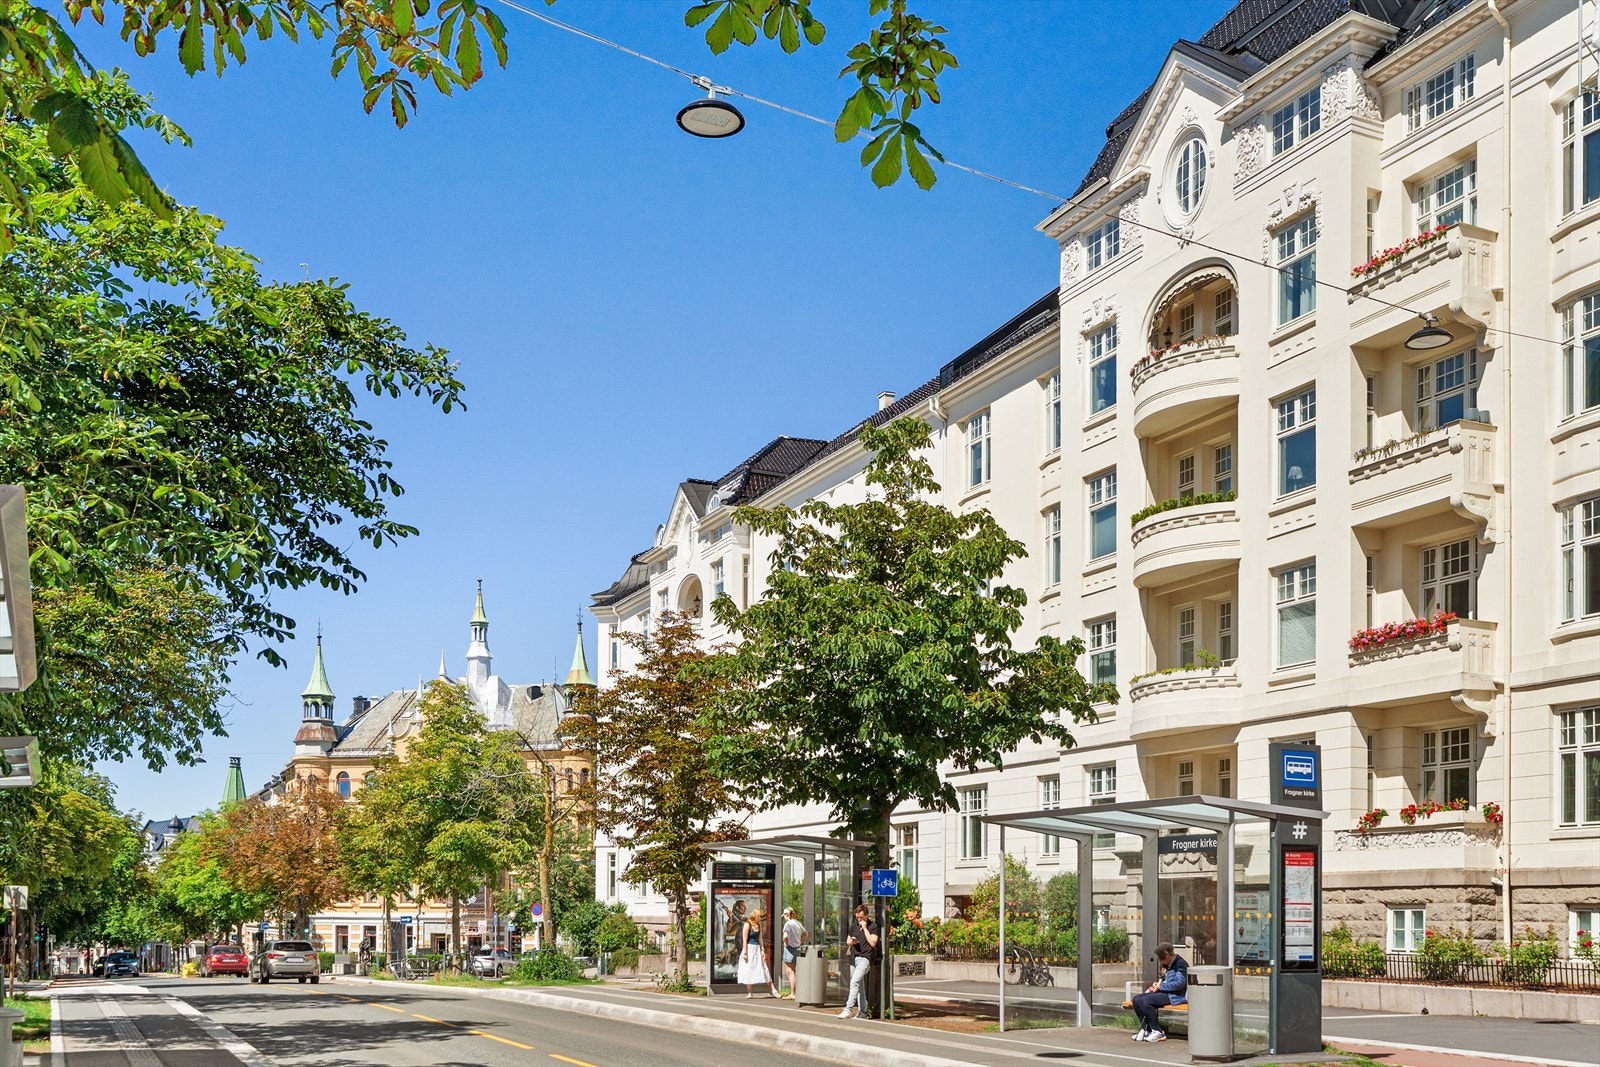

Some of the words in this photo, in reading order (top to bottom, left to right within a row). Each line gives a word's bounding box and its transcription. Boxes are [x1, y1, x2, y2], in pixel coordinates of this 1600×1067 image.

[1284, 788, 1303, 797] Frogner
[1172, 839, 1200, 851] Frogner
[1200, 838, 1217, 849] kirke
